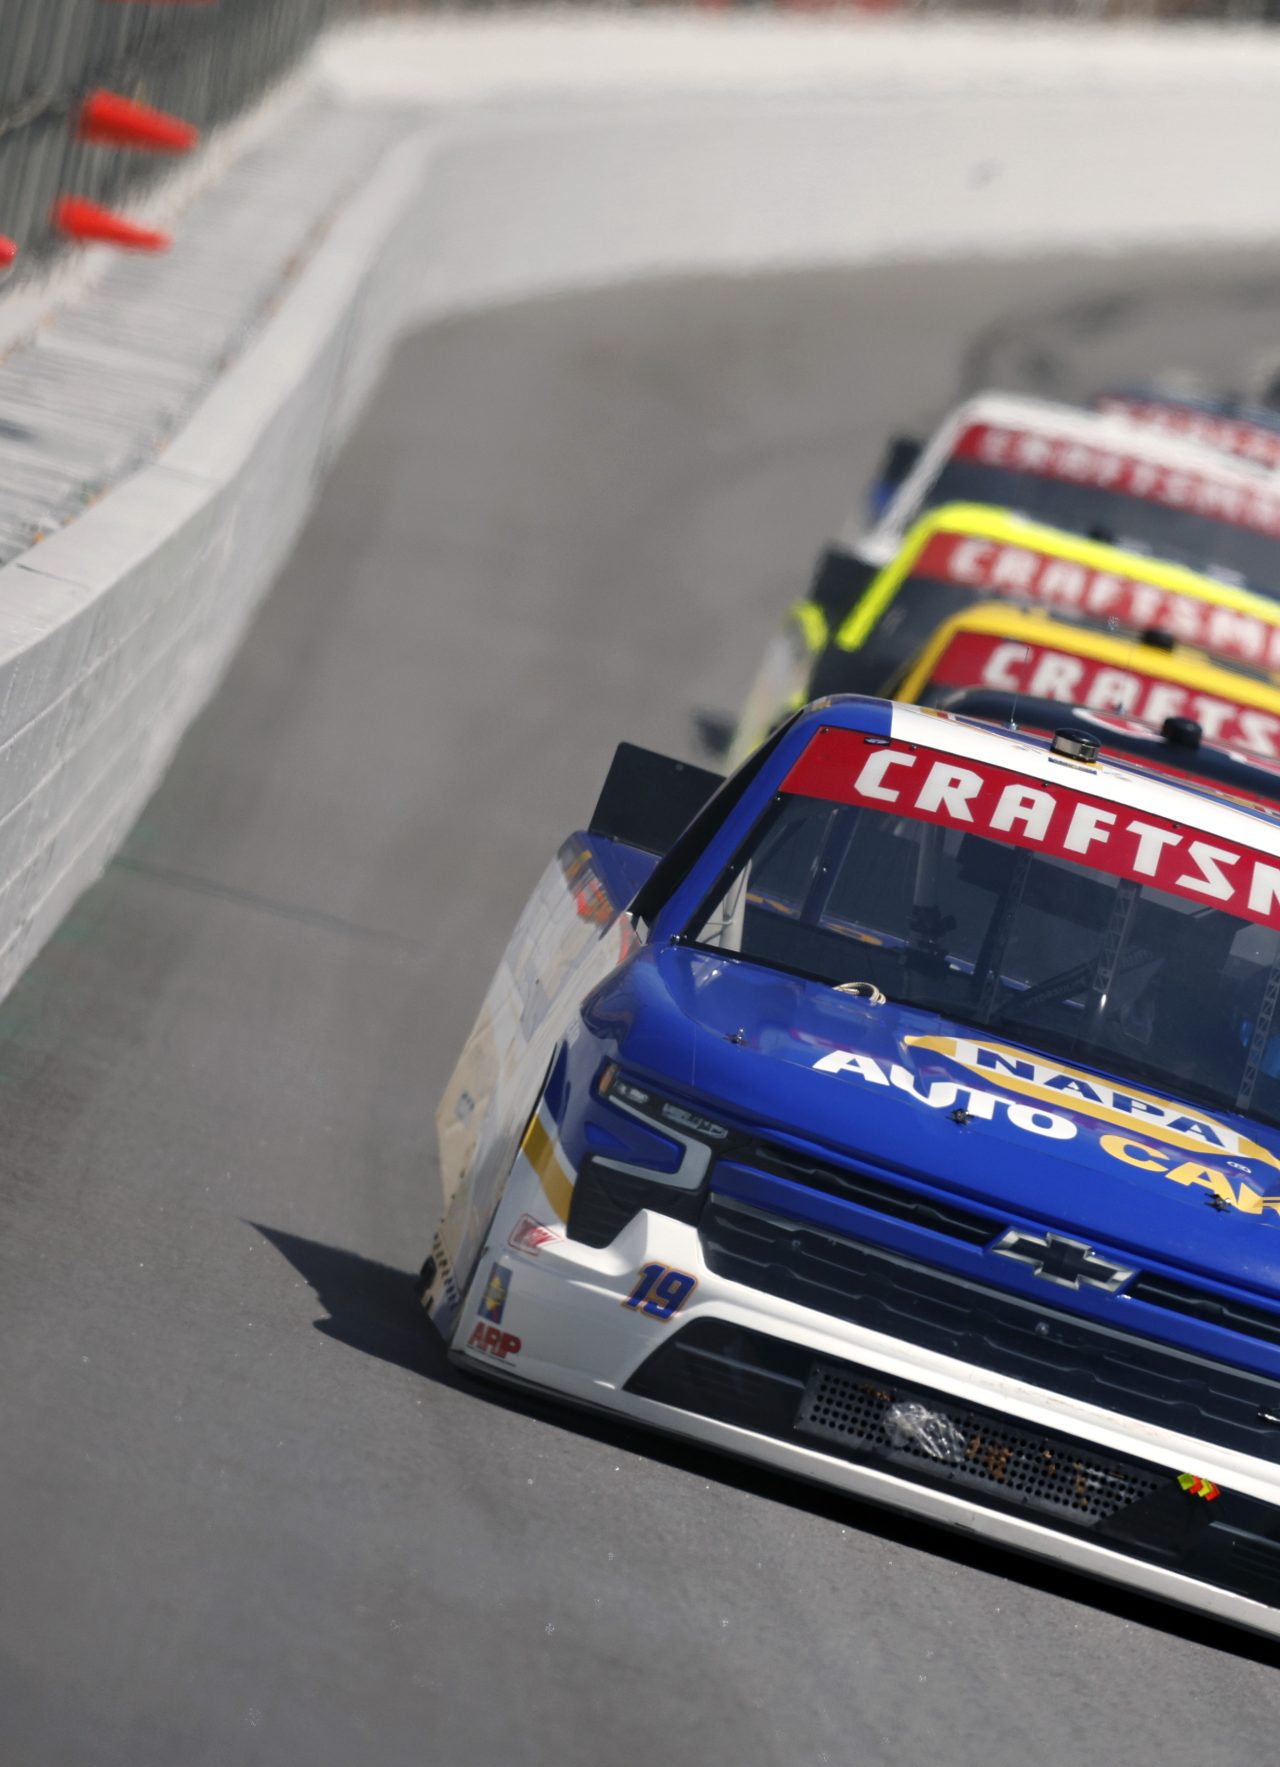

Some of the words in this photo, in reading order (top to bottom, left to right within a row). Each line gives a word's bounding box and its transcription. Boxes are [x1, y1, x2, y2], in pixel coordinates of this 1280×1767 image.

[812, 1050, 1078, 1140] AUTO
[975, 1047, 1226, 1148] NAPA
[620, 1261, 698, 1323] 19
[468, 1321, 522, 1359] ARP
